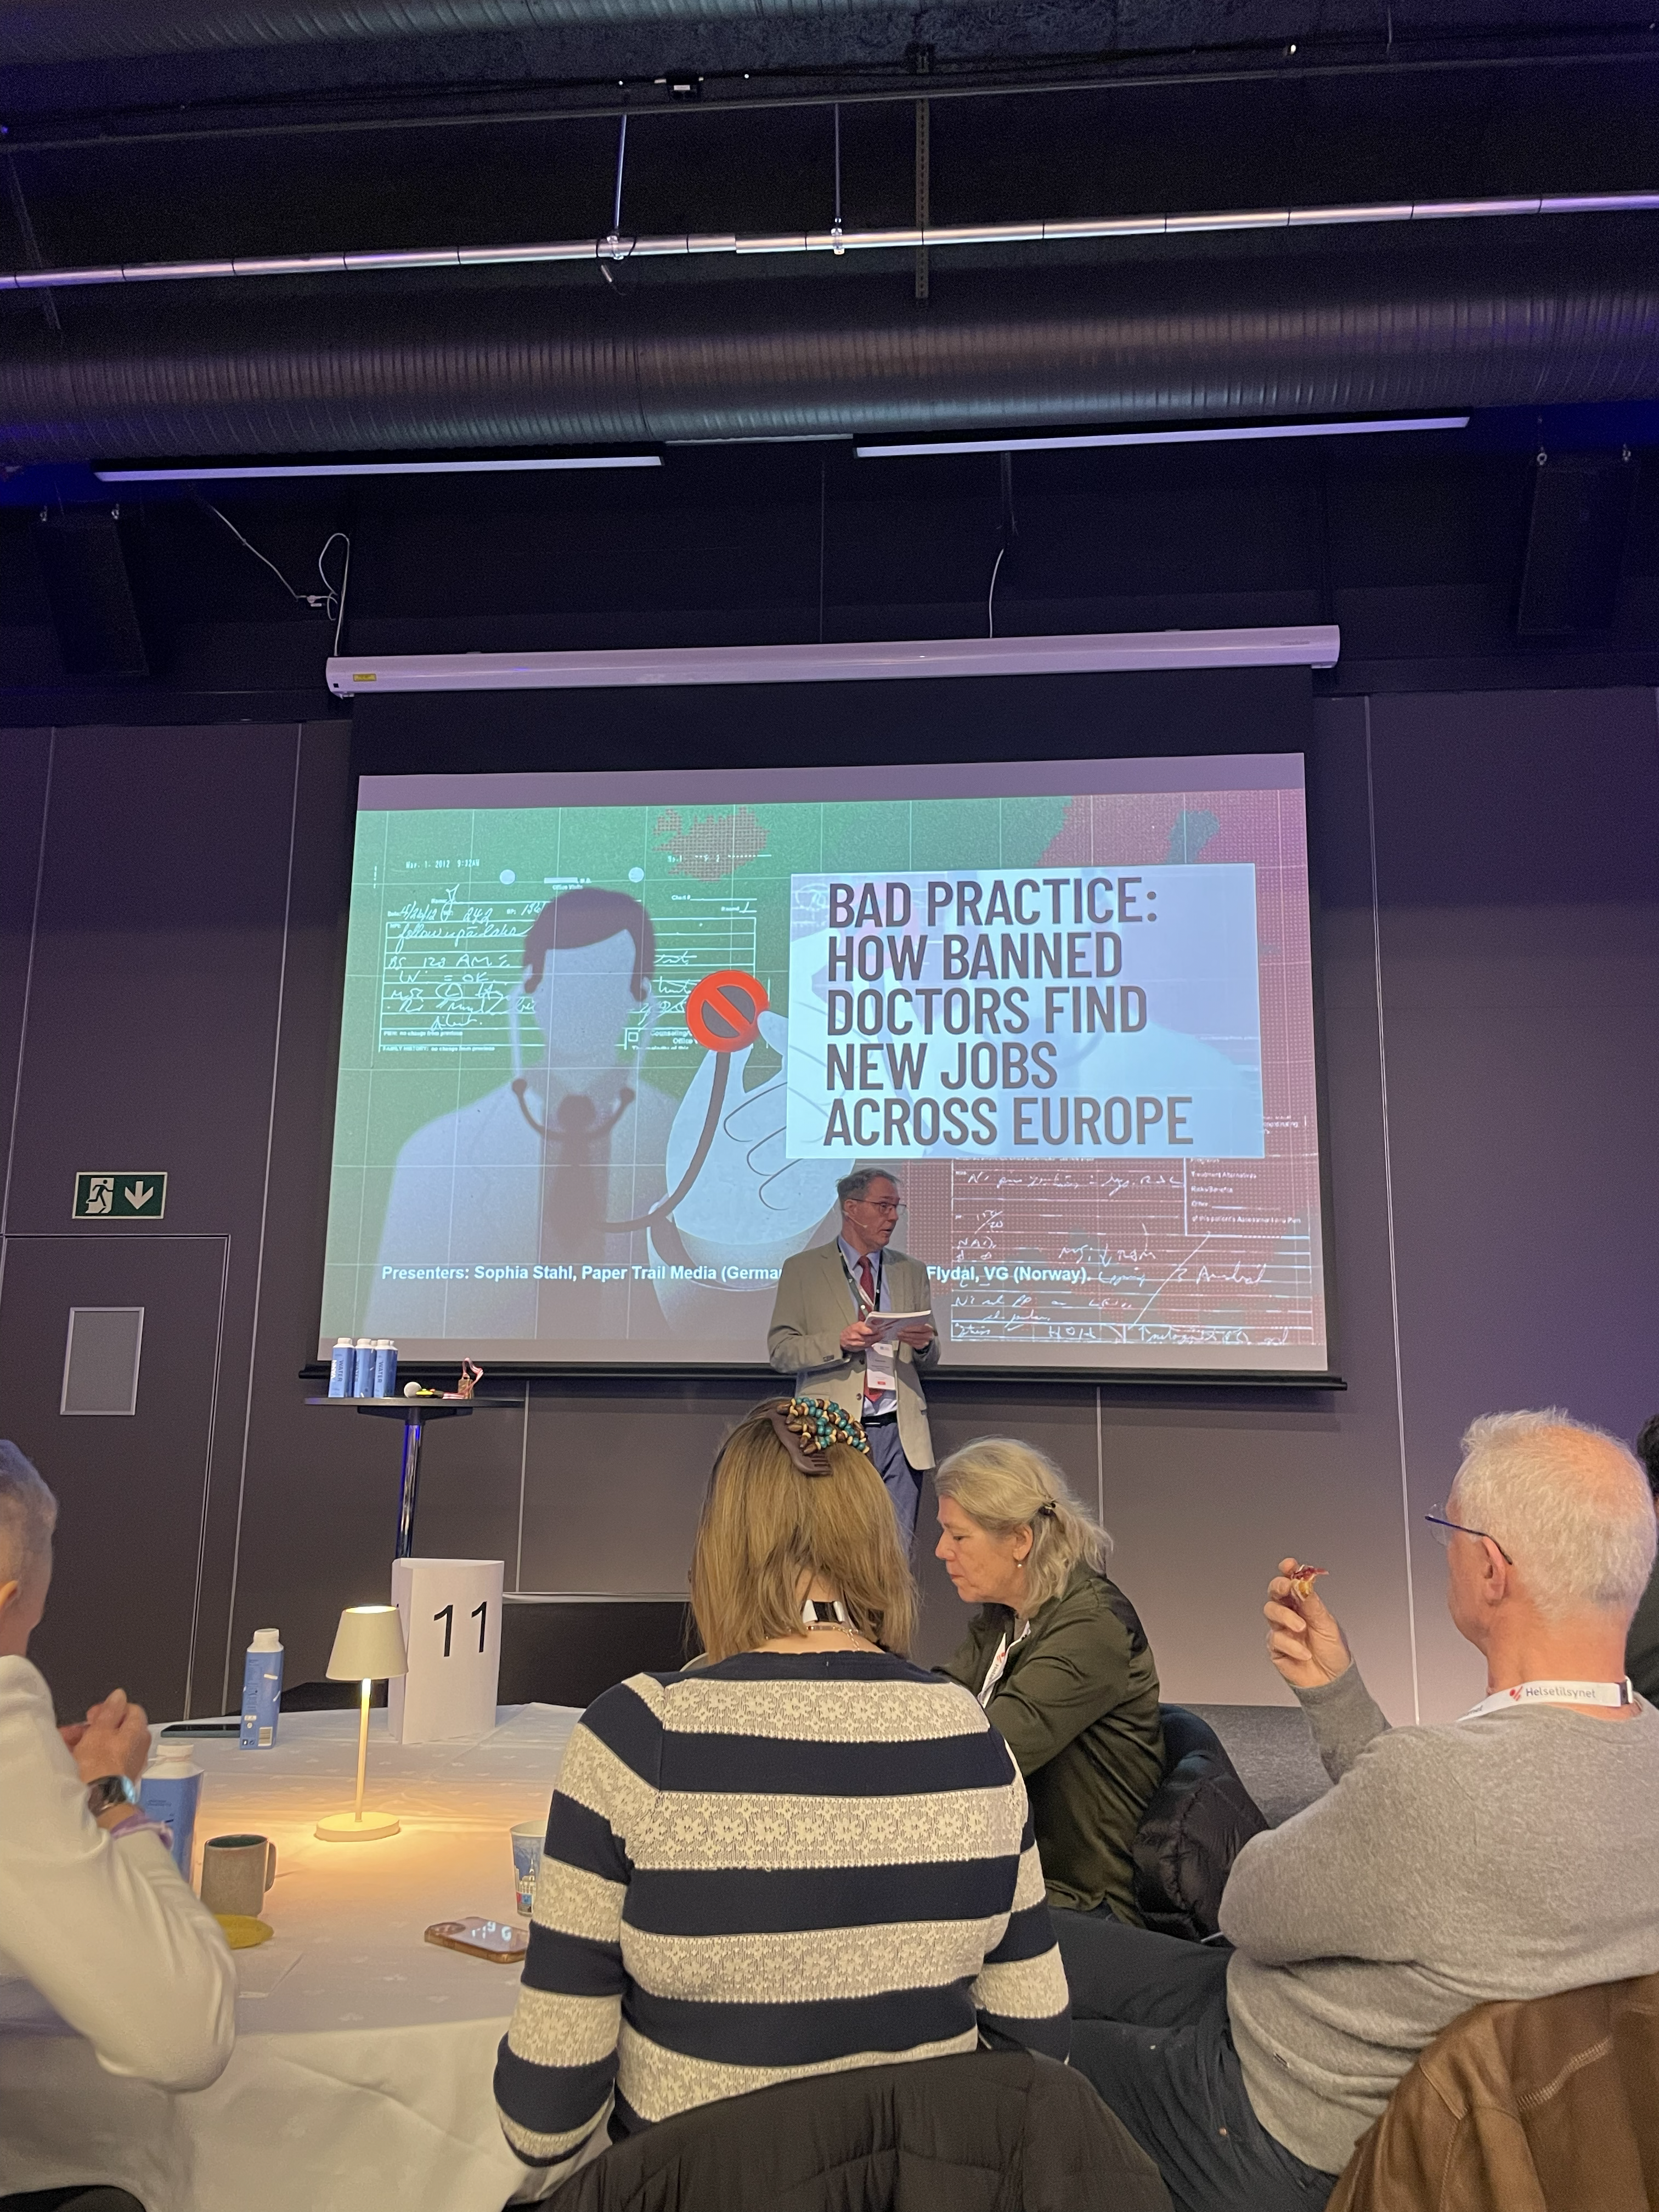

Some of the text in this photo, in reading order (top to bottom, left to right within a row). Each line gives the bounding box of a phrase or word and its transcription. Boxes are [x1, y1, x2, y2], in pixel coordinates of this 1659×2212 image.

[435, 859, 450, 868] 2012
[828, 878, 1157, 929] BAD PRACTICE:
[828, 932, 1122, 983] HOW BANNED
[827, 985, 1147, 1036] DOCTORS FIND
[826, 1041, 1058, 1091] NEW JOBS
[823, 1096, 1194, 1147] ACROSS EUROPE
[381, 1265, 470, 1280] Presenters:
[473, 1266, 529, 1283] Sophia
[532, 1265, 578, 1282] Stahl,
[581, 1266, 629, 1283] Paper
[631, 1266, 666, 1280] Trail
[669, 1265, 716, 1280] Media
[926, 1266, 980, 1283] Flydal,
[983, 1266, 1009, 1280] VG
[1013, 1266, 1091, 1284] (Norway).
[432, 1600, 489, 1658] 11
[1525, 1686, 1596, 1700] Helsetilsynet
